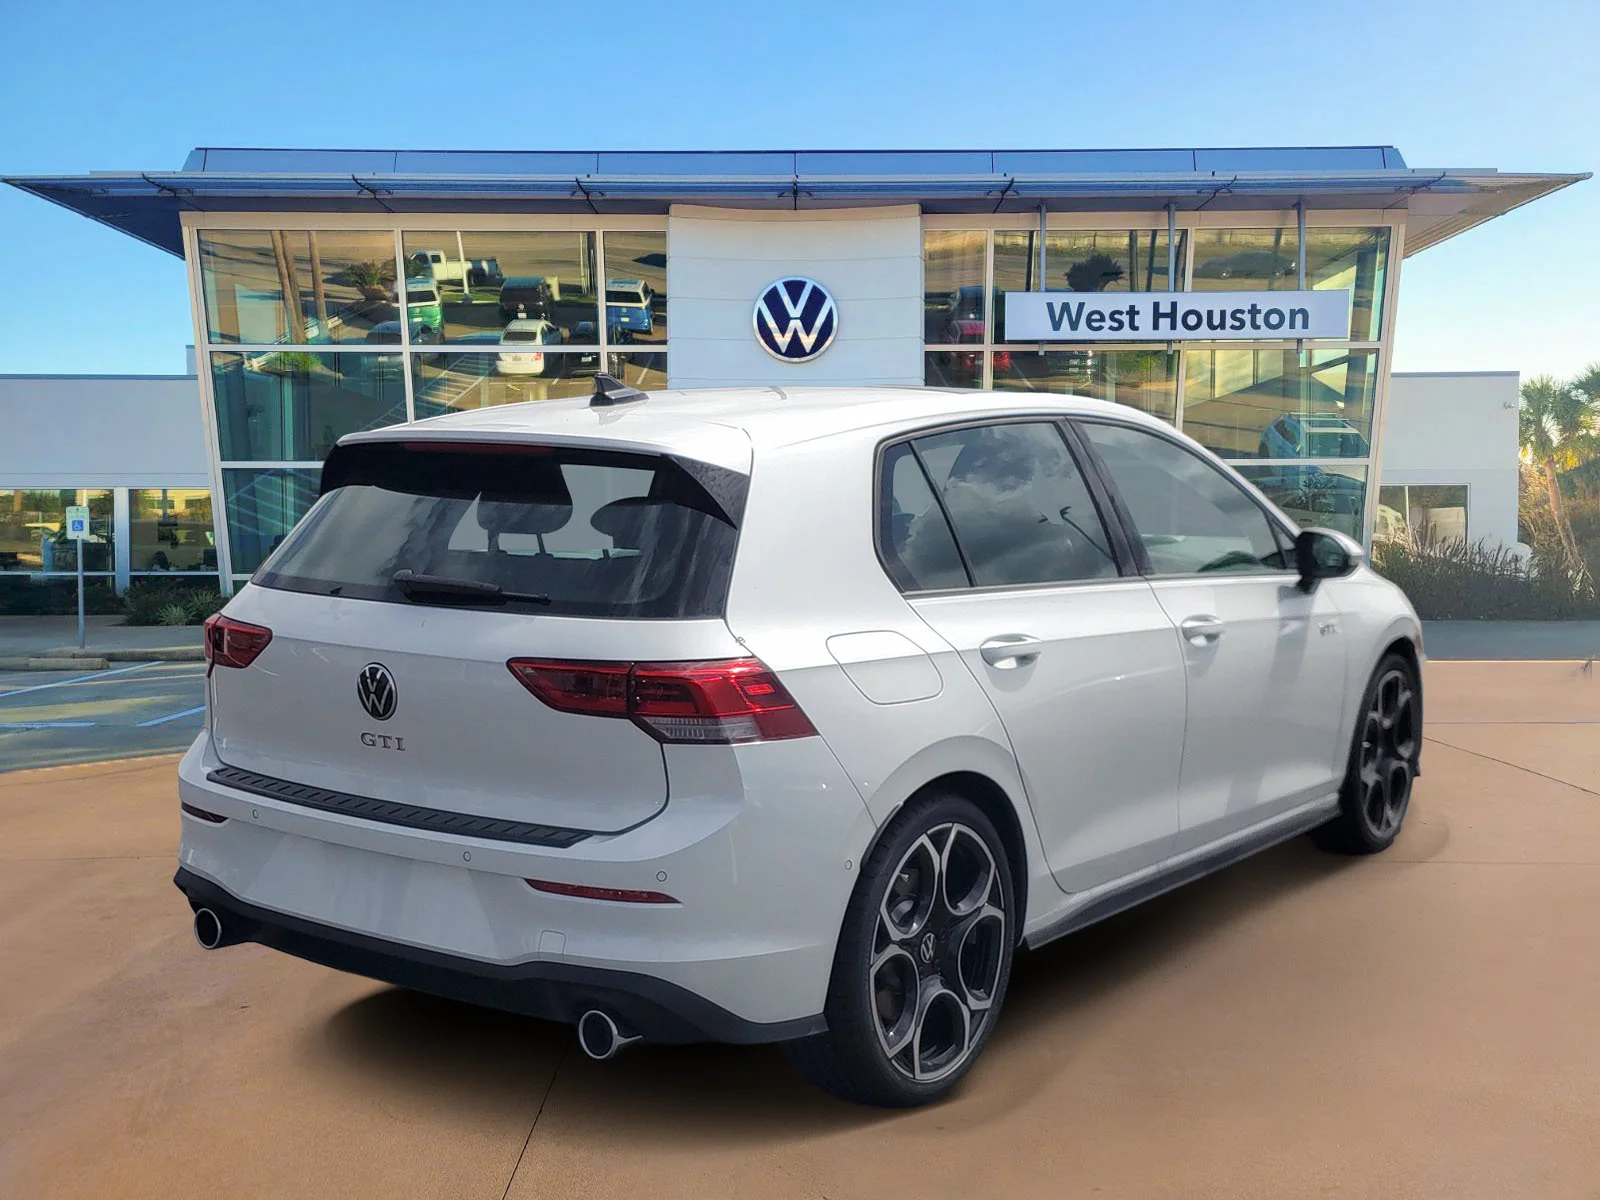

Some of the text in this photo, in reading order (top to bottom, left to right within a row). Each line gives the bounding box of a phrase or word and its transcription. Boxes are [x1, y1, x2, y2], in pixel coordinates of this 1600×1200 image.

[755, 277, 837, 359] VW
[1046, 301, 1310, 332] West Houston
[358, 663, 397, 719] VW
[360, 731, 406, 751] GTI
